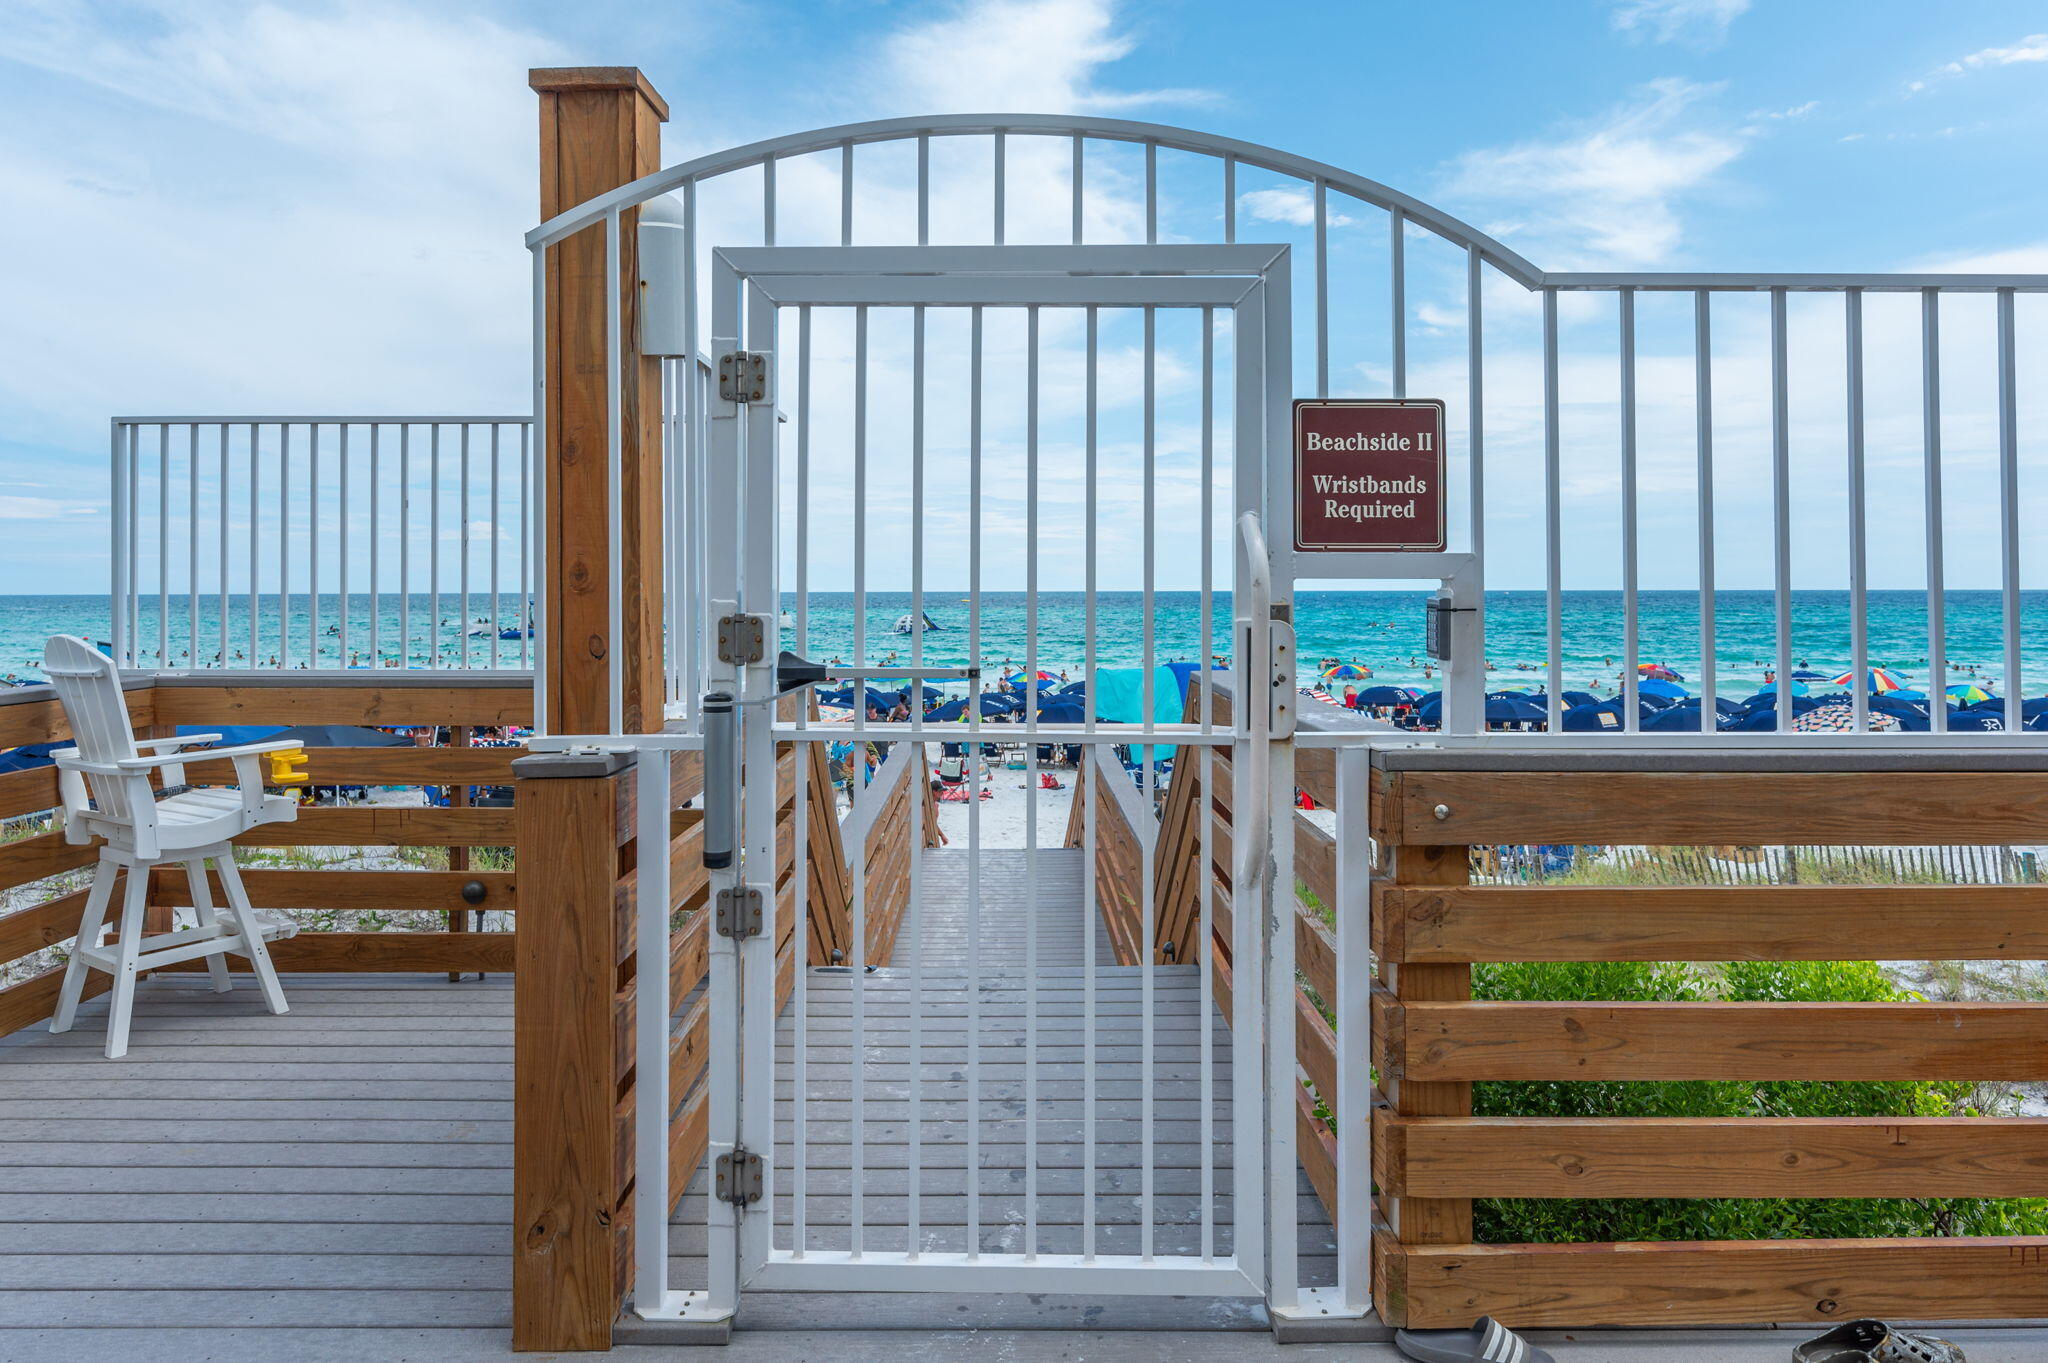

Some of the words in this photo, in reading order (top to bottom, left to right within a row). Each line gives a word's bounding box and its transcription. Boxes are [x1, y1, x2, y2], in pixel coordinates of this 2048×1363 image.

[1307, 433, 1410, 451] Beachside
[1417, 433, 1432, 450] II
[1313, 475, 1426, 493] Wristbands
[1325, 500, 1415, 522] Required
